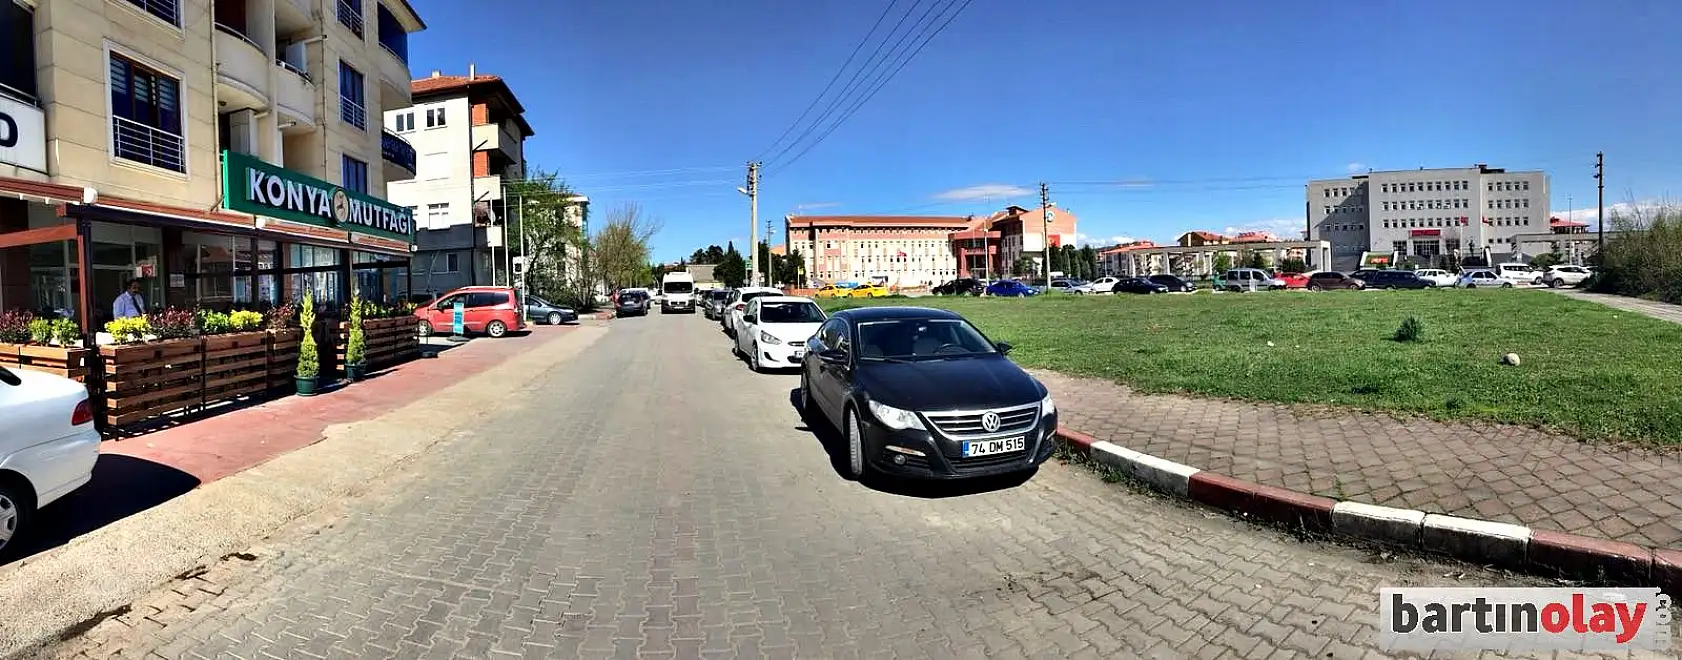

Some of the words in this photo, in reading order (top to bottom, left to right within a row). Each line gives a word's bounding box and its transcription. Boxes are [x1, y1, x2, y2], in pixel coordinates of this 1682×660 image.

[248, 167, 332, 218] KONYA
[349, 198, 411, 235] MUTFAĞI
[971, 444, 985, 454] 74
[989, 441, 1003, 453] DM
[1005, 438, 1023, 451] 515
